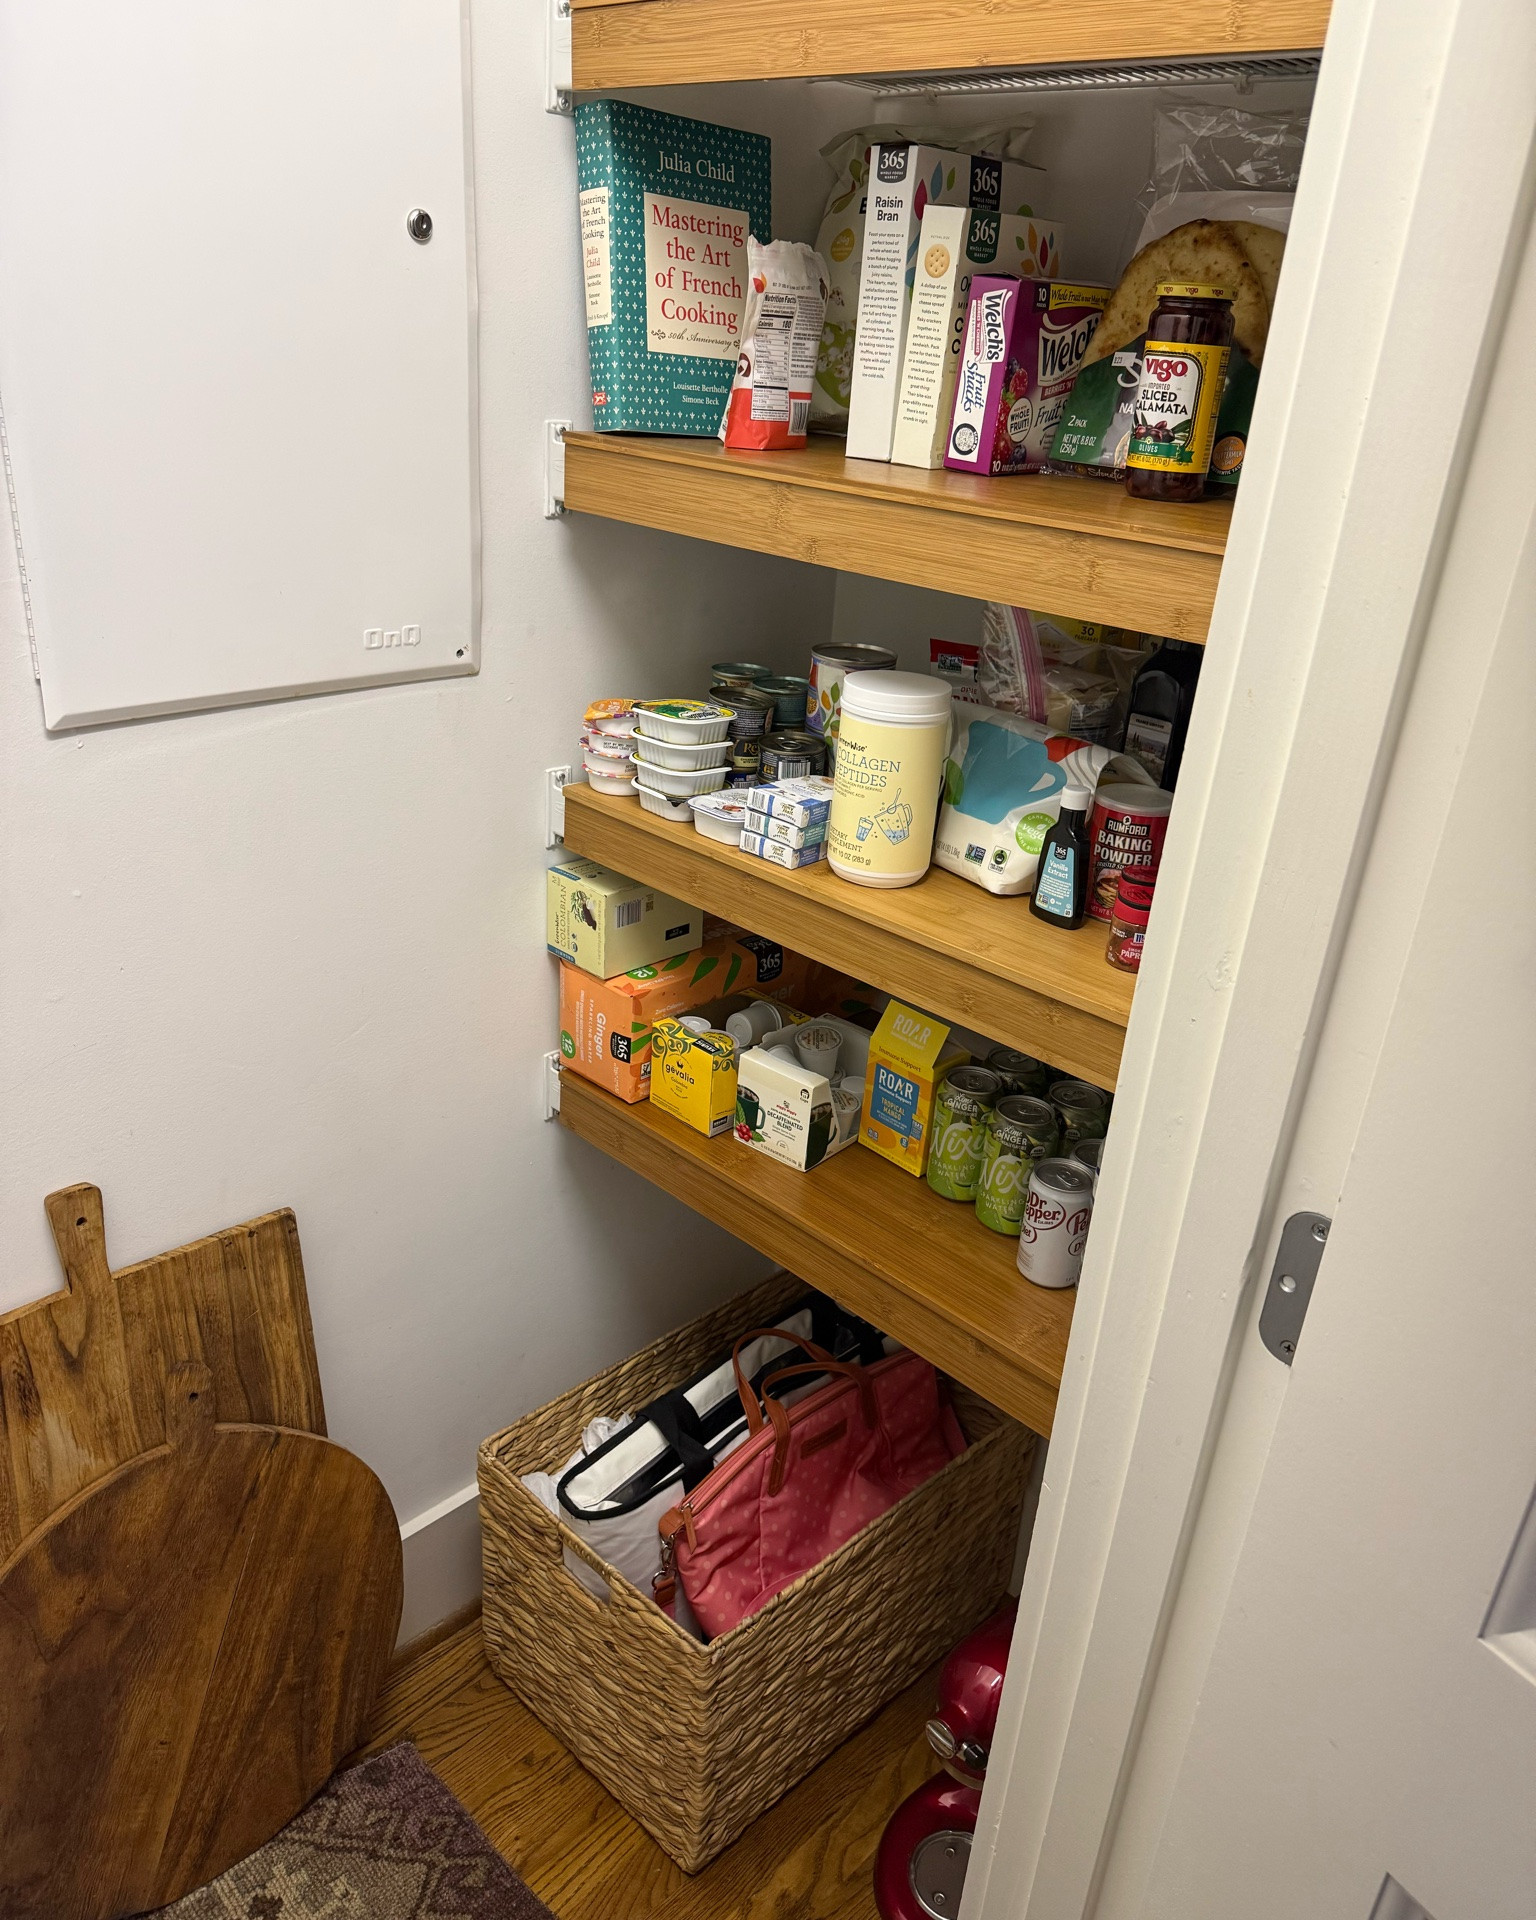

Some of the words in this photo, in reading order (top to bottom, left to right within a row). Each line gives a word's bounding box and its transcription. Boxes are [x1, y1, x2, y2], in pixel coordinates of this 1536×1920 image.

[657, 151, 691, 174] Julia
[696, 159, 735, 183] Child
[881, 150, 905, 169] 365
[973, 167, 998, 195] 365
[875, 196, 903, 209] Raisin
[586, 218, 605, 228] French
[877, 209, 899, 222] Bran
[652, 204, 744, 248] Mastering
[971, 218, 997, 245] 365
[583, 230, 604, 240] Cooking
[586, 247, 598, 258] Julia
[666, 237, 695, 262] the
[701, 244, 731, 267] Art
[586, 258, 600, 268] Child
[655, 266, 675, 288] of
[682, 270, 743, 299] French
[765, 294, 784, 303] Nutrition
[785, 295, 796, 304] Facts
[1039, 288, 1046, 301] 10
[1052, 289, 1067, 300] Whole
[1069, 290, 1081, 301] Fruit
[661, 298, 738, 334] Cooking
[985, 292, 1004, 360] Welch's
[668, 329, 685, 340] 50th
[686, 331, 733, 352] Anniversary
[1042, 317, 1098, 377] Welch'
[673, 381, 700, 392] Louisette
[702, 383, 728, 394] Bertholle
[964, 360, 978, 413] Snacks
[974, 372, 985, 409] Fruit
[1044, 383, 1065, 396] BERRIES
[682, 395, 705, 404] Simone
[706, 396, 719, 405] Beck
[1142, 389, 1177, 402] SLICED
[1010, 408, 1030, 422] WHOLE
[1034, 400, 1062, 427] Fruit
[1068, 415, 1074, 426] 2
[1010, 418, 1029, 435] FRUIT!
[1062, 434, 1072, 443] NET
[1089, 437, 1096, 446] OZ
[1060, 444, 1078, 456] (250g)
[1139, 443, 1158, 453] OLIVES
[992, 460, 1001, 472] 10
[1087, 468, 1124, 479] Stonefir
[1080, 625, 1095, 637] 30
[839, 737, 865, 752] reenWise
[1022, 824, 1045, 840] vega
[1108, 819, 1147, 836] RUMFORD
[1098, 830, 1152, 851] BAKING
[839, 849, 843, 857] 10
[844, 851, 851, 859] OZ
[852, 853, 865, 864] (283
[865, 857, 871, 866] g)
[1056, 846, 1067, 856] 365
[1093, 844, 1152, 866] POWDER
[1048, 867, 1068, 879] Extract
[1050, 860, 1068, 871] Vanilla
[1121, 949, 1142, 959] PAPR
[760, 953, 781, 973] 365
[594, 1012, 606, 1060] Ginger
[892, 1014, 931, 1045] ROAR
[564, 1038, 573, 1054] 12
[618, 1036, 628, 1060] 365
[696, 1040, 716, 1053] KEURIG
[879, 1046, 900, 1061] Immune
[900, 1057, 921, 1072] Support
[879, 1069, 913, 1100] ROAR
[895, 1093, 911, 1106] Support
[947, 1098, 978, 1113] GINGER
[955, 1093, 973, 1104] Lime
[881, 1097, 905, 1116] TROPICAL
[883, 1106, 902, 1120] MANGO
[767, 1110, 803, 1131] DECAFFEINATED
[777, 1121, 792, 1131] BLEND
[997, 1129, 1028, 1146] GINGER
[1003, 1125, 1023, 1137] Lime
[930, 1122, 986, 1161] Nixi
[932, 1160, 975, 1171] SPARKLING
[938, 1169, 966, 1181] WATER
[979, 1154, 1034, 1194] Nixi
[985, 1201, 1015, 1214] WATER
[1030, 1191, 1047, 1210] Dr
[1026, 1206, 1061, 1223] epper
